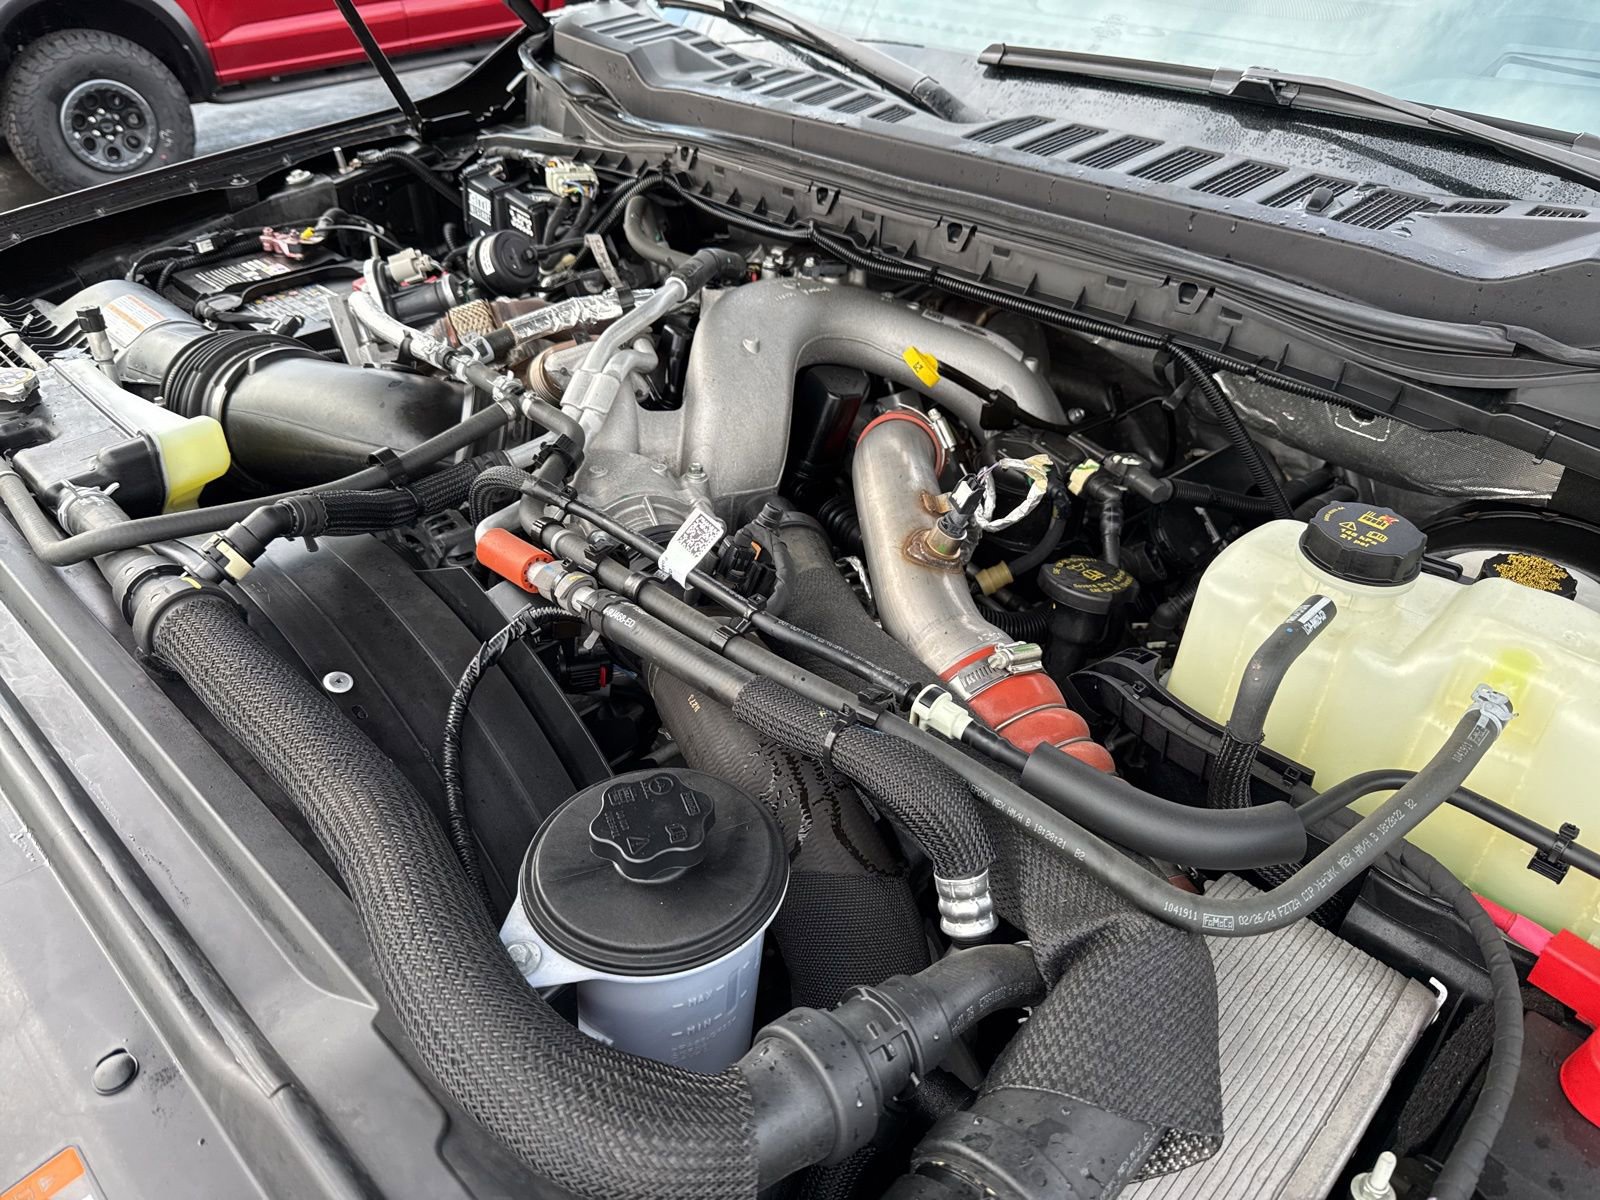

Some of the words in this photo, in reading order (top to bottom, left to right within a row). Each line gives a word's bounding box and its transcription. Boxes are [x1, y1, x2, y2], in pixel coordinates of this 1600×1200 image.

[1033, 823, 1067, 849] 18:28:21
[1163, 901, 1198, 920] 1041911
[1203, 914, 1233, 929] FoMoCo
[687, 990, 713, 1007] MAX
[686, 1017, 711, 1036] MIN
